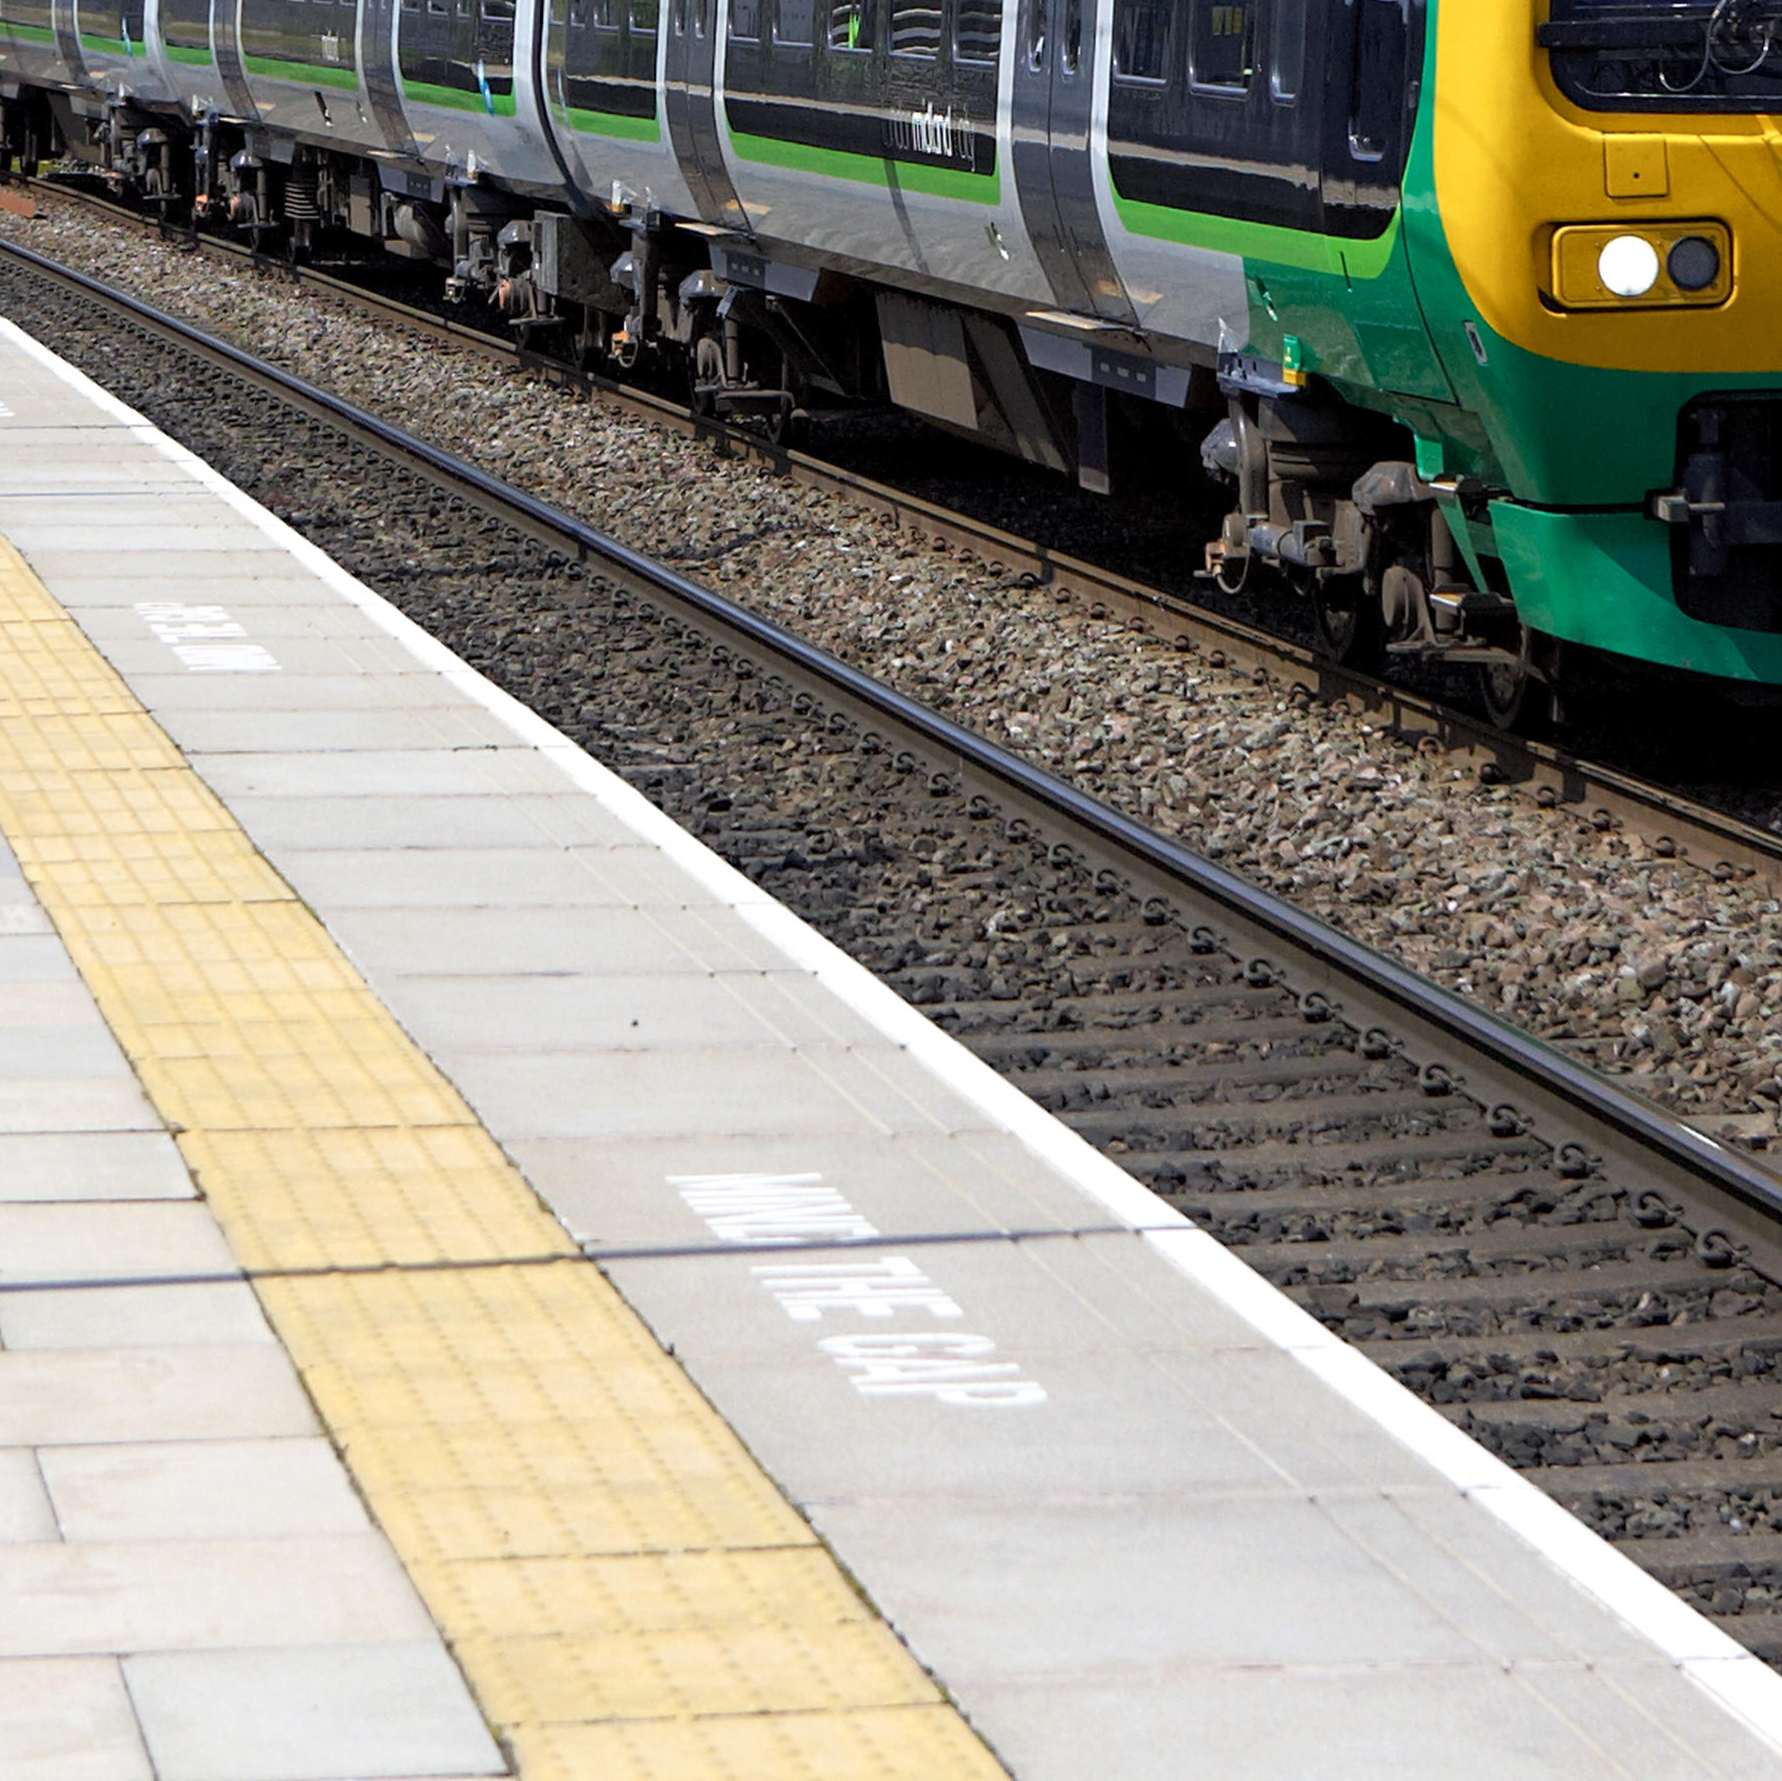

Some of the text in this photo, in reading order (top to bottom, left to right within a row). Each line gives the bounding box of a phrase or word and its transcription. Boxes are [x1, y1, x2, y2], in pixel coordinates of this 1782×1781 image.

[665, 1172, 1049, 1408] MIND THE GAP
